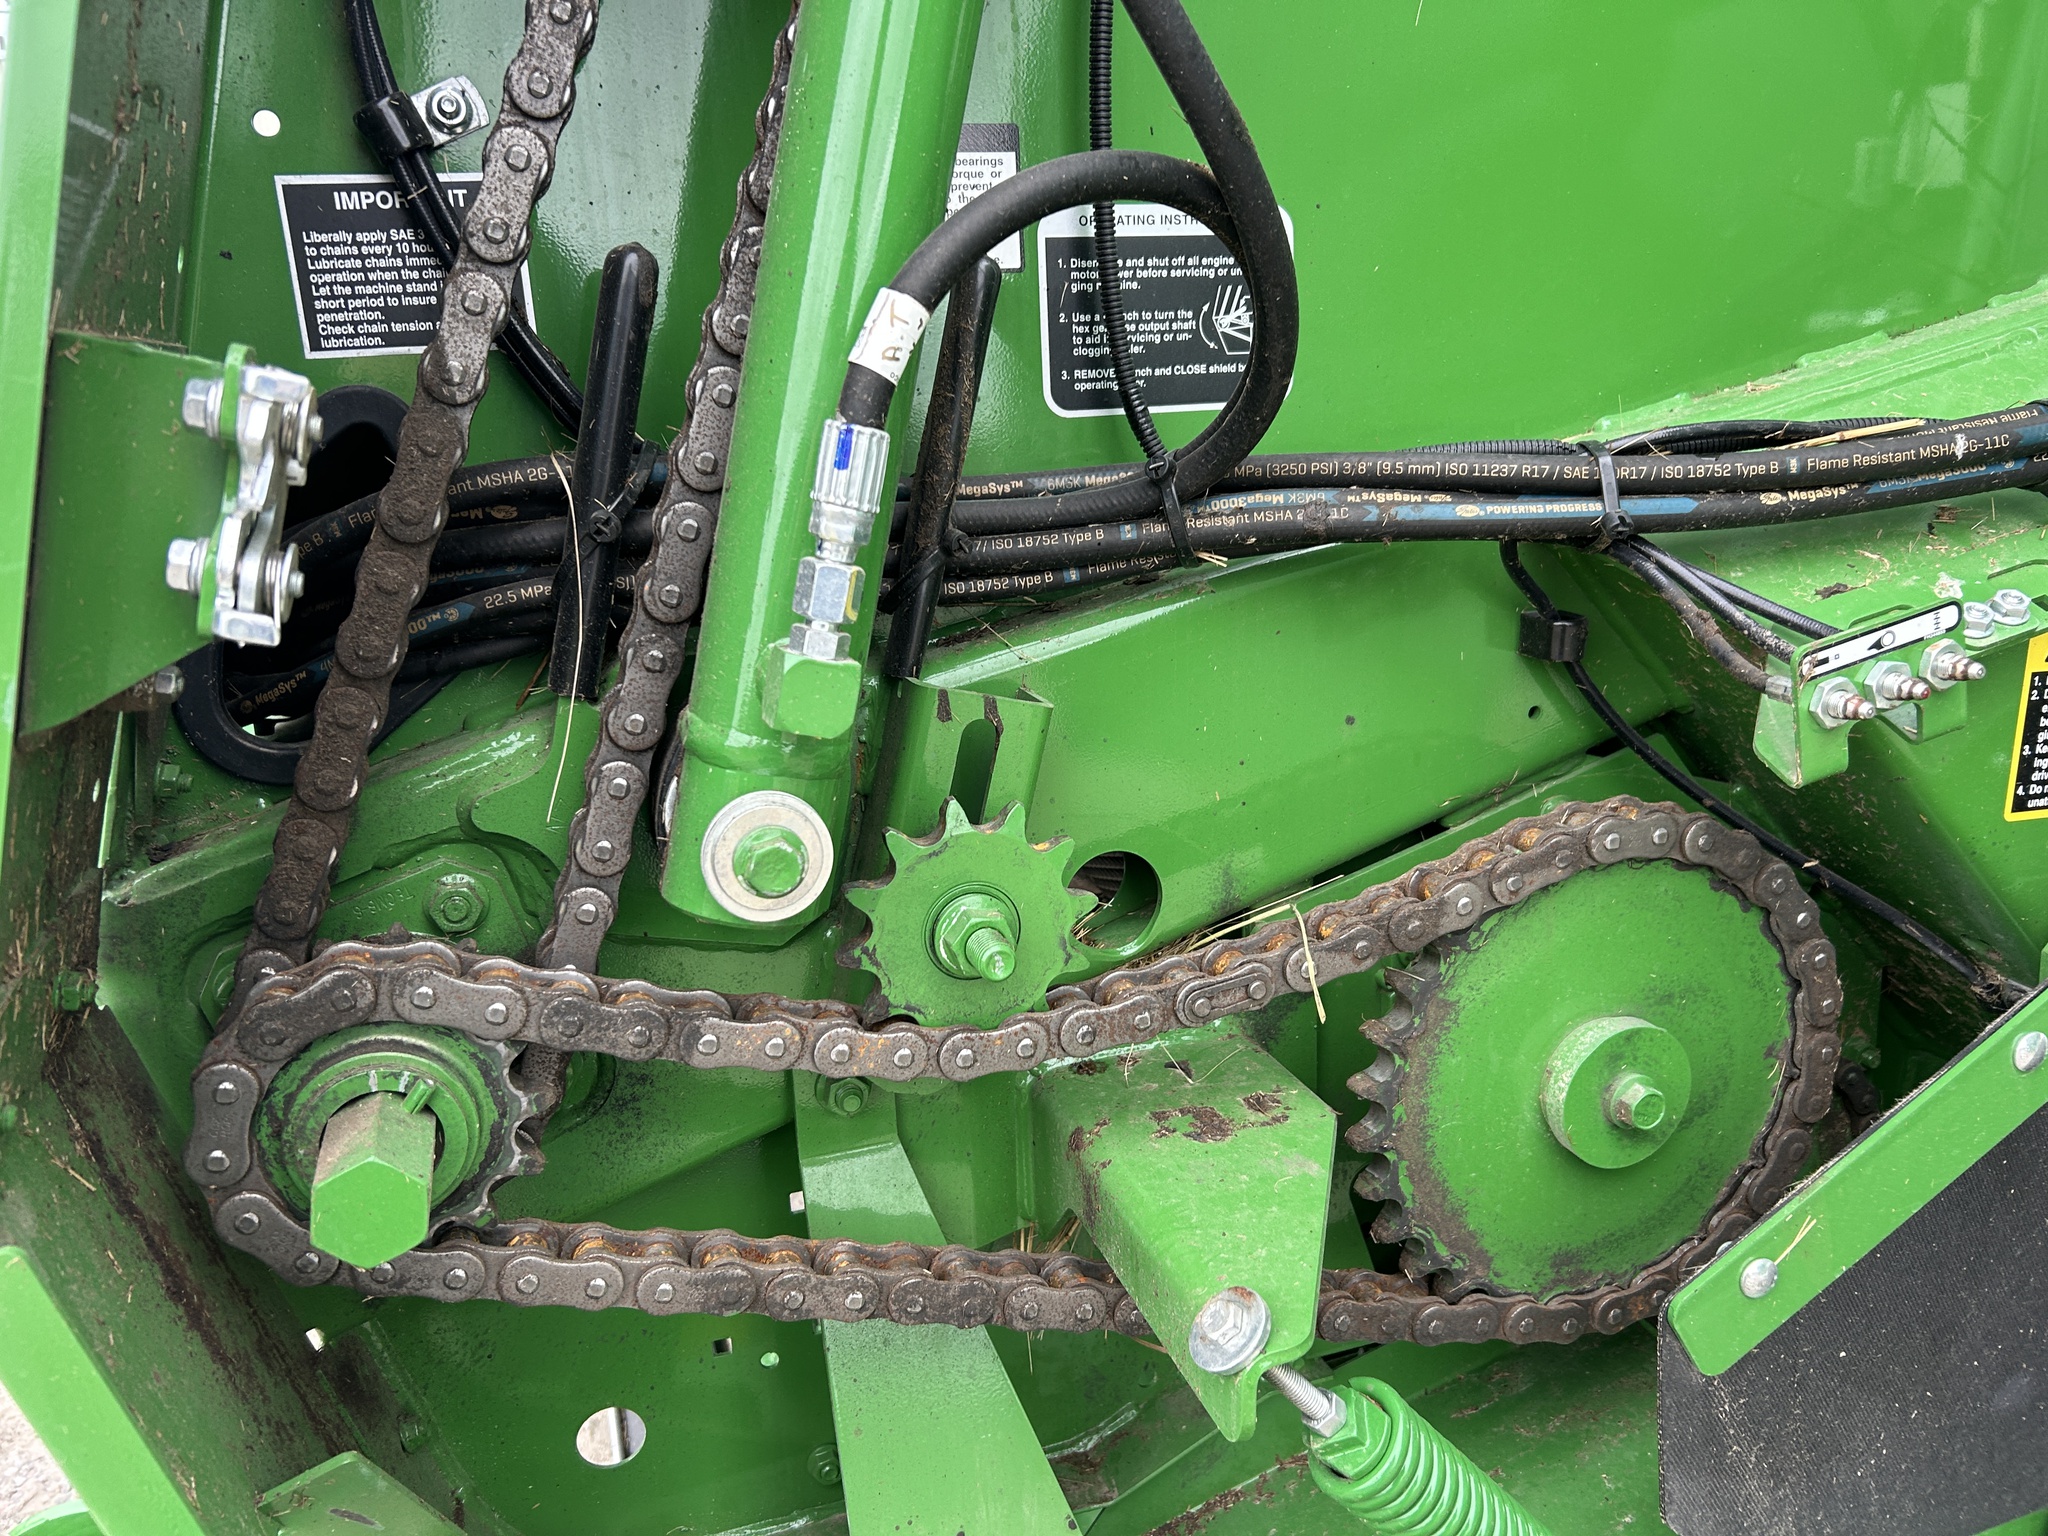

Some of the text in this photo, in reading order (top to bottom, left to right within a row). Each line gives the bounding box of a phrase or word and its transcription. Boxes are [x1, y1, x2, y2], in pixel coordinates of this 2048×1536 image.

[952, 170, 1003, 181] orque or
[1078, 214, 1156, 227] OPATING
[302, 230, 353, 245] Liberally
[355, 229, 387, 244] apply
[389, 228, 416, 241] SAE
[304, 242, 434, 257] to chains every 10 hou
[306, 257, 363, 270] Lubricate
[364, 255, 404, 268] chains
[1057, 257, 1067, 269] 1.
[1125, 255, 1145, 268] and
[1146, 255, 1170, 267] shut
[1171, 255, 1186, 266] off
[1187, 254, 1200, 266] all
[1201, 254, 1235, 268] engine
[309, 270, 366, 285] operation
[367, 269, 399, 281] when
[400, 267, 420, 280] the
[1136, 267, 1168, 279] before
[1170, 266, 1216, 279] servicing
[1217, 268, 1229, 276] or
[311, 284, 332, 297] Let
[332, 283, 352, 296] the
[354, 282, 404, 295] machine
[405, 281, 438, 293] stand
[1070, 280, 1093, 293] ging
[314, 294, 438, 311] short period to insure
[316, 309, 386, 325] penetration.
[1059, 313, 1069, 323] 2.
[1072, 312, 1091, 322] Use
[1094, 313, 1100, 322] a
[1141, 310, 1152, 320] to
[1154, 309, 1175, 320] turn
[1177, 309, 1193, 319] the
[318, 323, 356, 336] Check
[357, 322, 389, 334] chain
[390, 320, 434, 333] tension
[1072, 323, 1090, 334] hex
[1138, 319, 1170, 333] output
[1171, 319, 1197, 331] shaft
[320, 335, 386, 349] lubrication.
[1072, 335, 1083, 345] to
[1085, 334, 1101, 345] aid
[1162, 332, 1174, 342] or
[1176, 332, 1193, 341] un-
[1072, 345, 1112, 358] cloggin
[1061, 370, 1071, 380] 3.
[1074, 368, 1116, 380] REMOVE
[1154, 365, 1172, 376] and
[1173, 364, 1207, 375] CLOSE
[1208, 362, 1236, 374] shield
[1074, 380, 1120, 392] operating
[1233, 464, 1262, 477] MPa
[1445, 462, 1468, 477] ISO
[1472, 463, 1518, 478] 11237
[1521, 464, 1549, 478] R17
[1563, 465, 1590, 480] SAE
[1660, 465, 1684, 479] ISO
[1688, 463, 1731, 478] 18752
[1734, 462, 1766, 480] Type
[1769, 461, 1779, 474] B
[1807, 457, 1850, 471] Flame
[1852, 448, 1917, 468] Resistant
[476, 470, 525, 489] MSHA
[1486, 503, 1544, 515] POWERING
[1546, 501, 1603, 514] PROGRESS
[991, 536, 1014, 550] ISO
[1017, 533, 1059, 549] 18752
[1061, 531, 1092, 546] Type
[1095, 528, 1105, 539] B
[1253, 509, 1294, 523] MSHA
[944, 582, 966, 594] ISO
[968, 576, 1010, 592] 18752
[1012, 574, 1042, 591] Type
[1044, 570, 1054, 583] B
[482, 589, 518, 610] 22.5
[520, 584, 553, 600] MPa
[2033, 675, 2042, 687] 1.
[2030, 689, 2040, 701] 2.
[2022, 744, 2032, 756] 3.
[2016, 784, 2026, 796] 4.
[2028, 783, 2043, 795] Do
